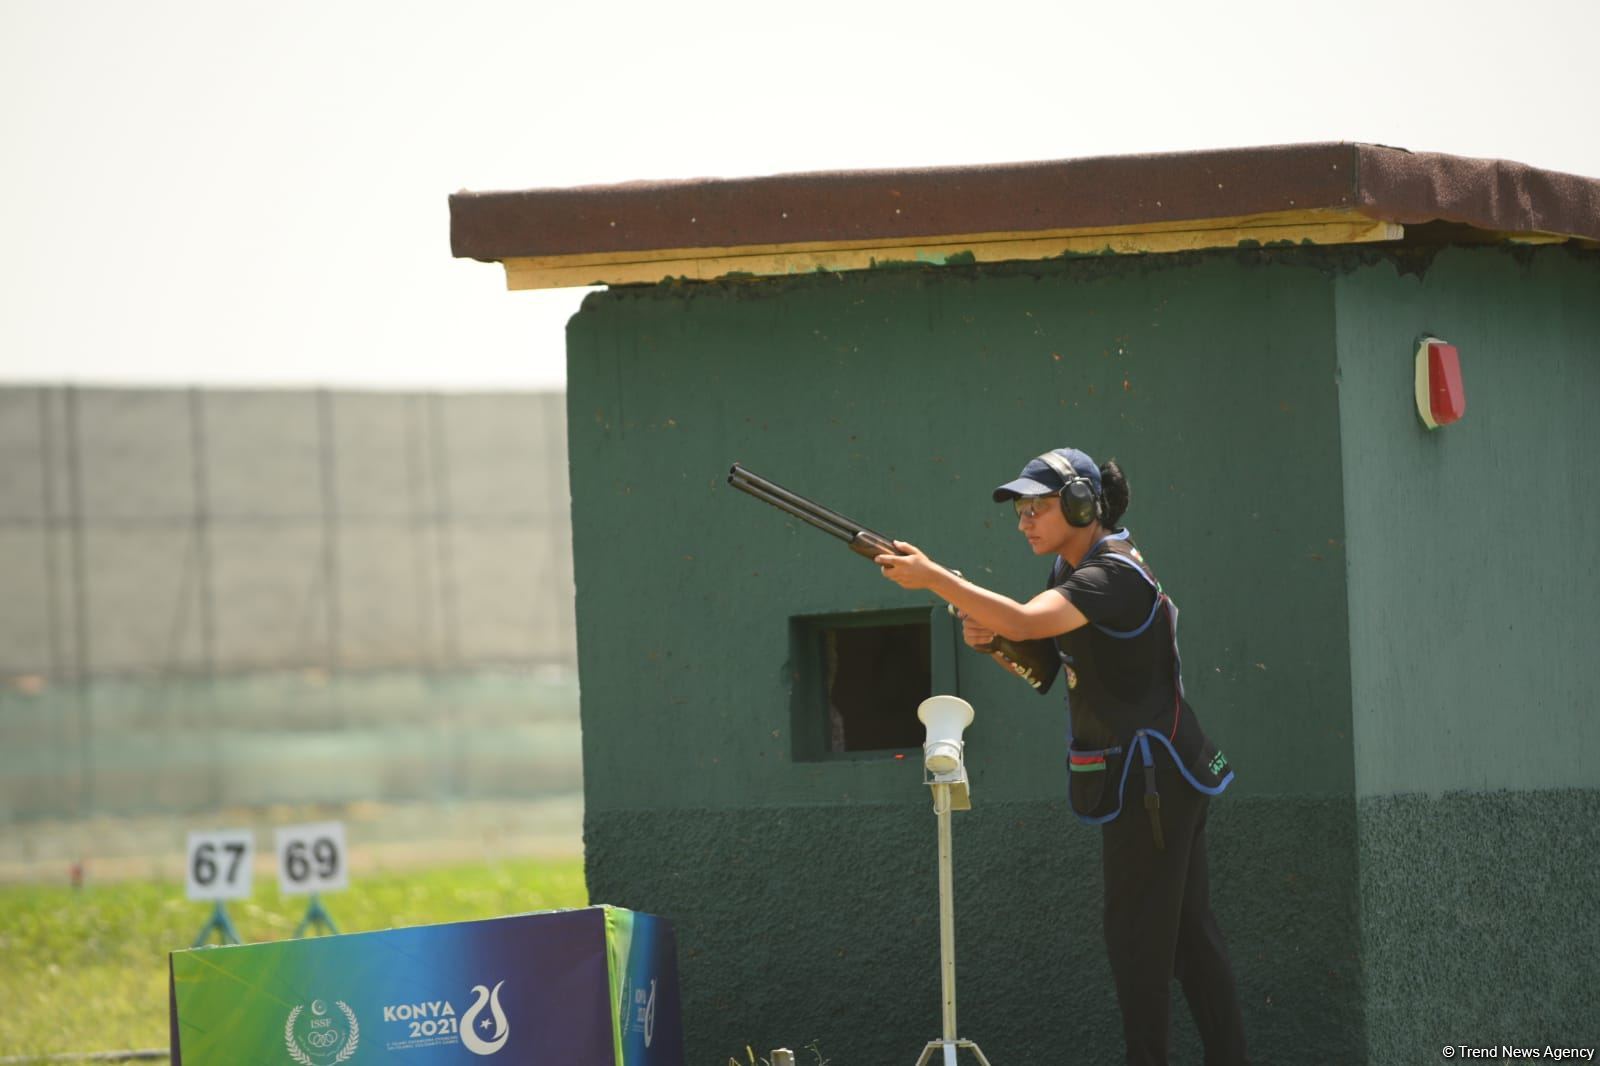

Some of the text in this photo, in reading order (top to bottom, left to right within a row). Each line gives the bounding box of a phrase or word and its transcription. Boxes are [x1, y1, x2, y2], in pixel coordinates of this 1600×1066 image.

[193, 841, 245, 886] 67
[286, 837, 339, 883] 69
[384, 1001, 455, 1022] KONYA
[409, 1018, 458, 1038] 2021
